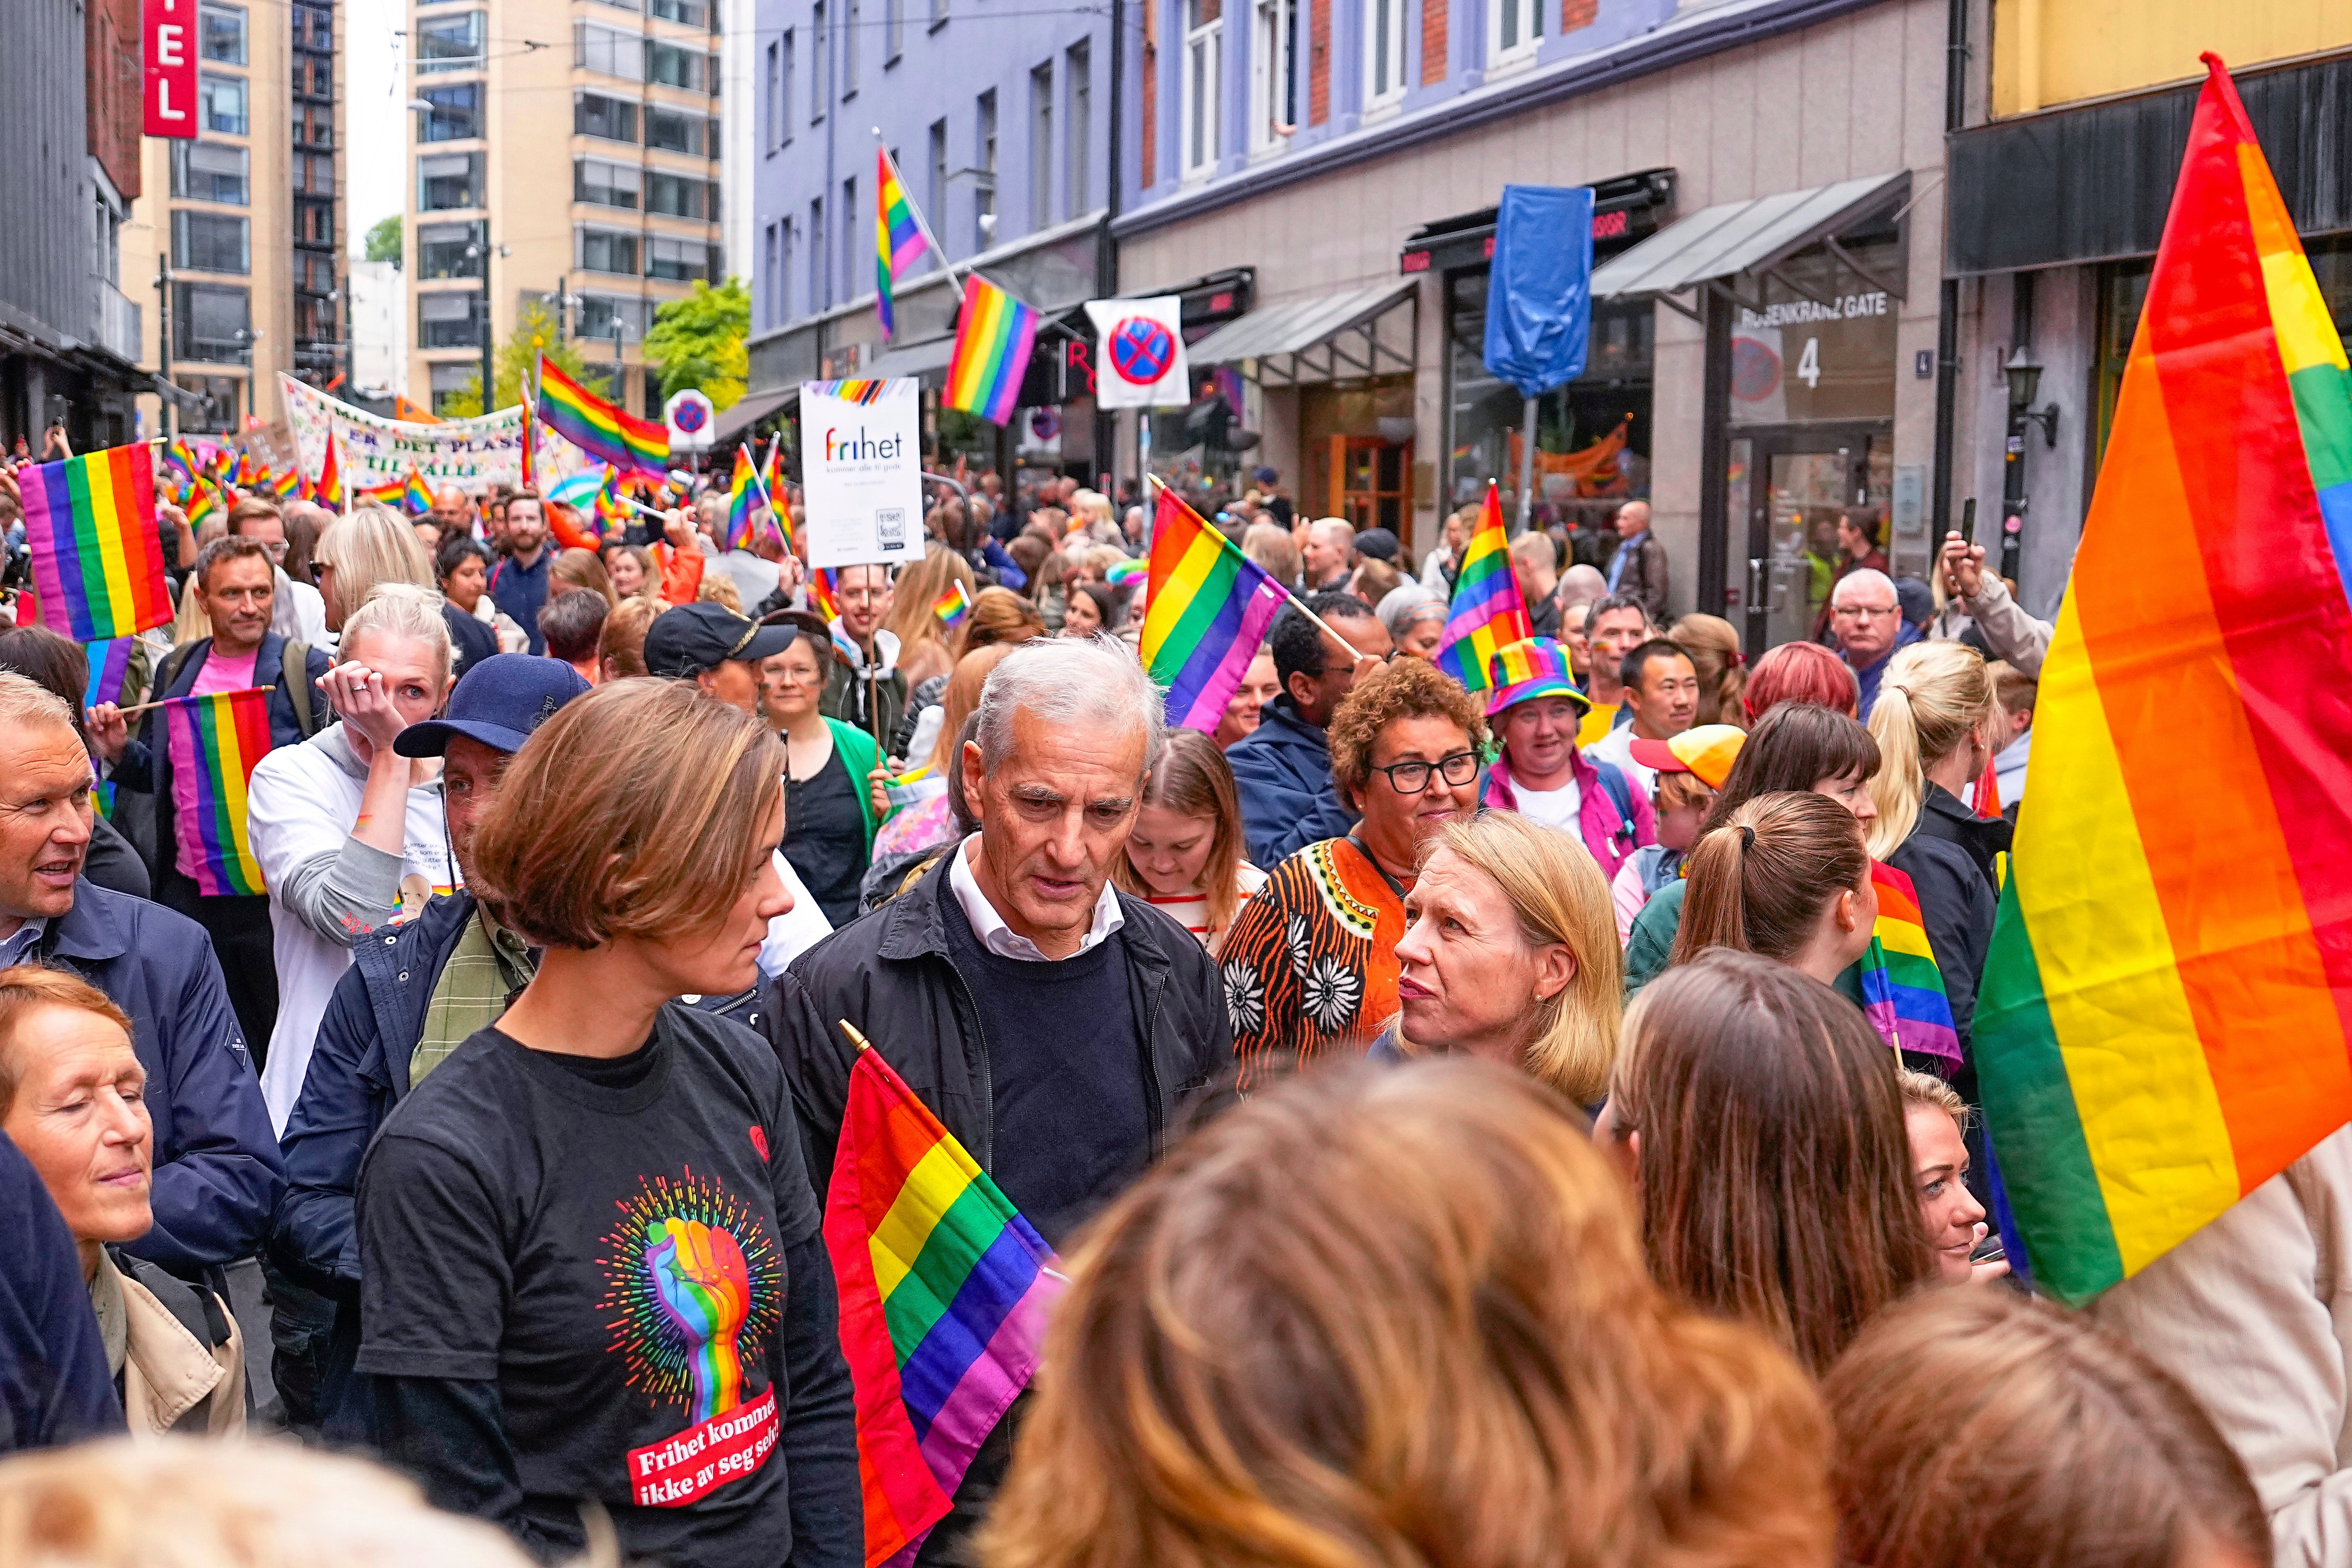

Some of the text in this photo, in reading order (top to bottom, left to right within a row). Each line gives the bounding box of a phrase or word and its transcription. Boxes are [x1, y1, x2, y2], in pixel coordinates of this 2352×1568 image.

[1844, 291, 1888, 318] GATE
[1797, 336, 1821, 389] 4
[394, 438, 440, 454] DET
[826, 425, 902, 461] frihet
[365, 455, 482, 477] TIL ALLE
[637, 1430, 707, 1477] Frihet
[640, 1418, 779, 1506] ikke av seg selv!
